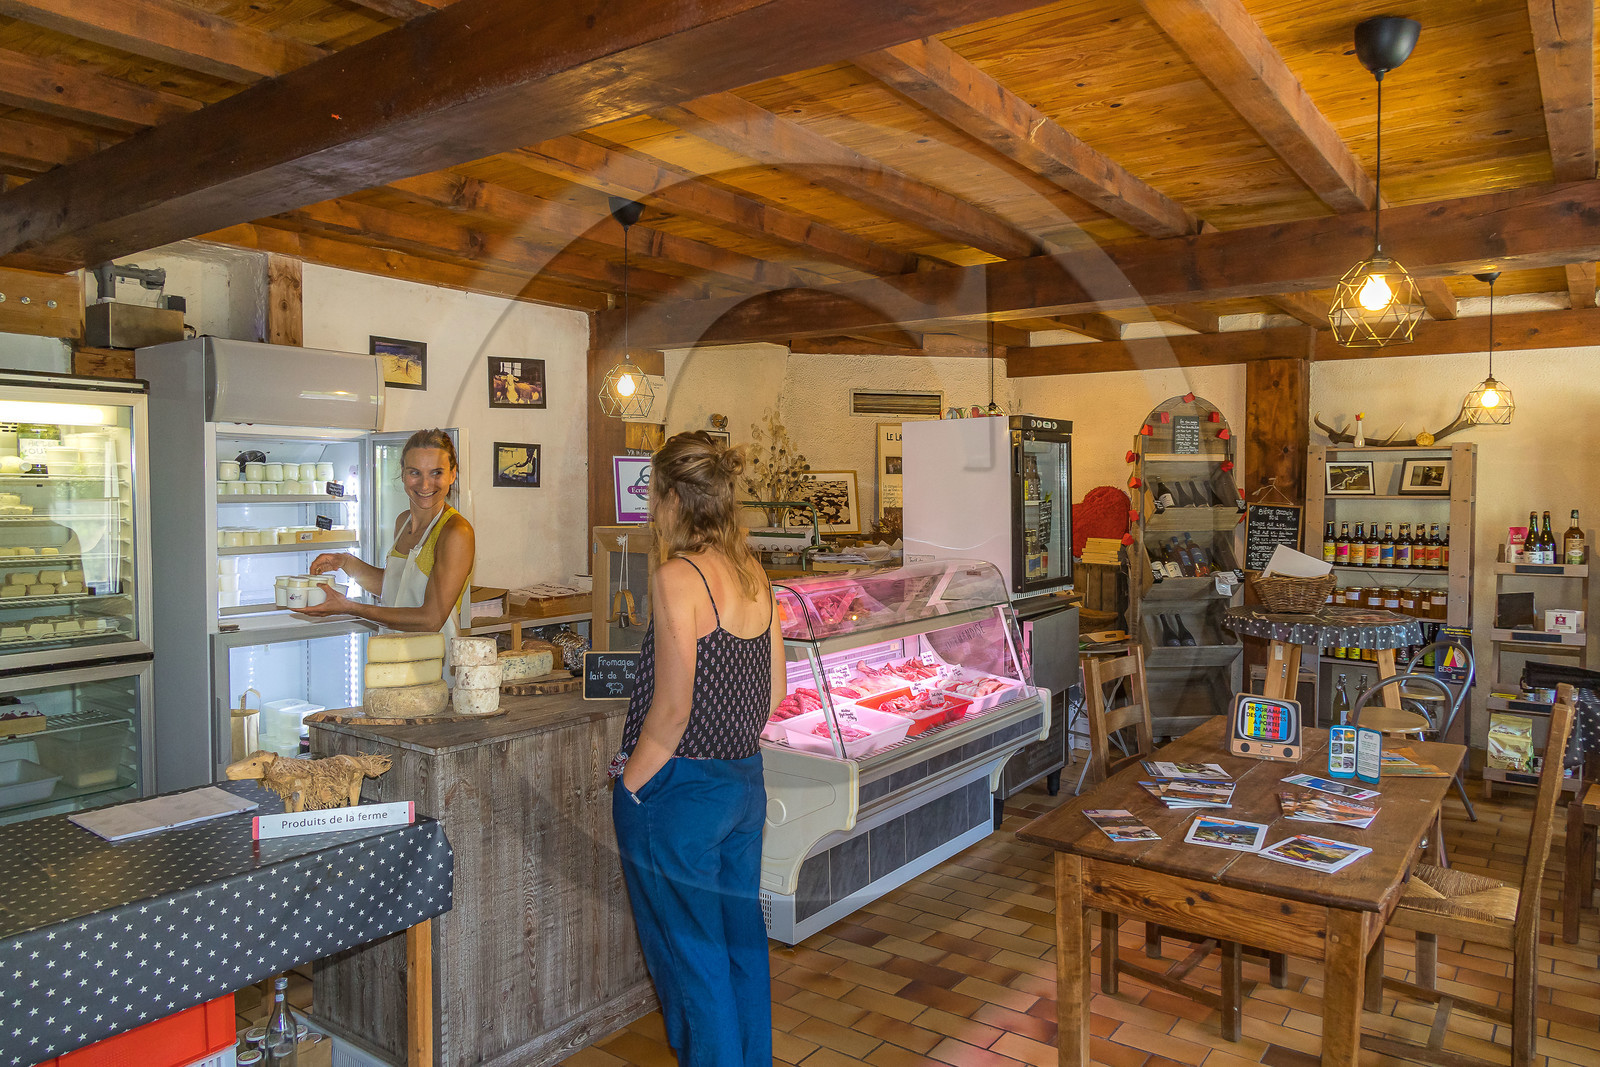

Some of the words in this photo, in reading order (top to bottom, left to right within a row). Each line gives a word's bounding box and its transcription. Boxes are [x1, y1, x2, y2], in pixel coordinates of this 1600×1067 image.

[886, 432, 894, 441] LE
[598, 655, 635, 672] Fromages
[590, 671, 604, 681] lait
[607, 671, 617, 680] de
[625, 670, 636, 680] bre
[1248, 706, 1286, 715] PROGRAMME
[281, 817, 326, 829] Produits
[329, 813, 343, 824] de
[345, 811, 355, 823] la
[358, 810, 388, 822] ferme
